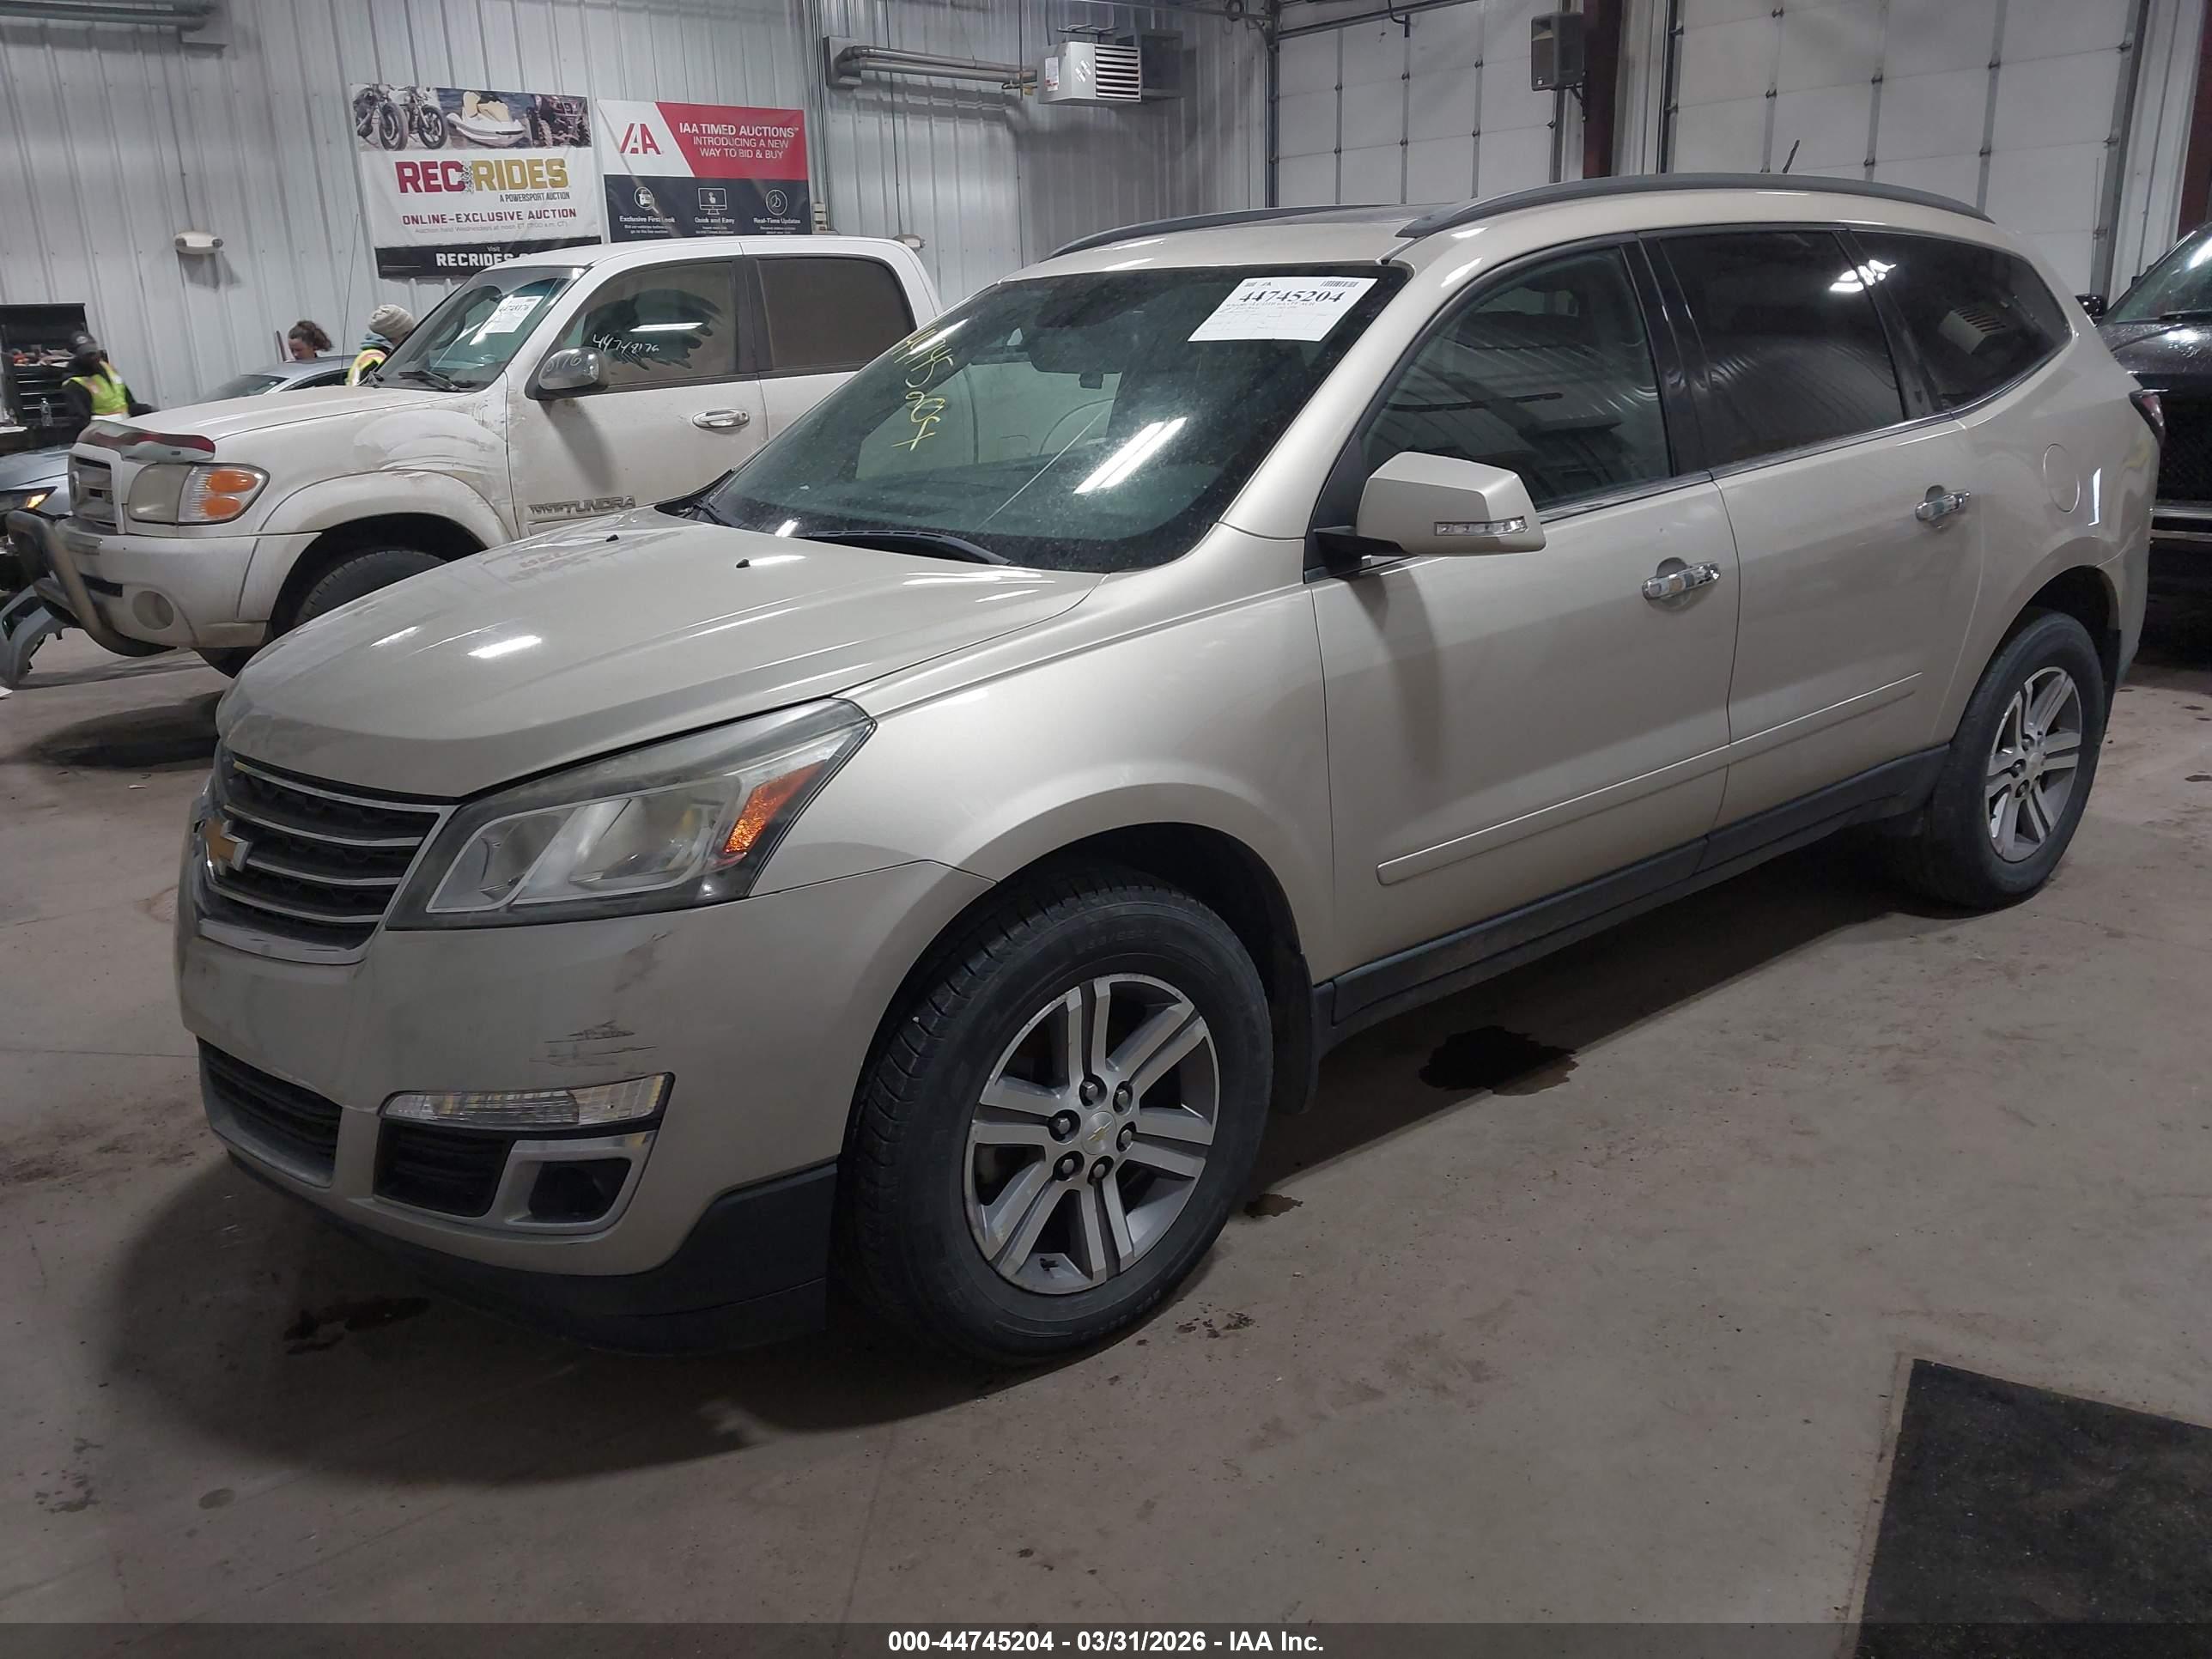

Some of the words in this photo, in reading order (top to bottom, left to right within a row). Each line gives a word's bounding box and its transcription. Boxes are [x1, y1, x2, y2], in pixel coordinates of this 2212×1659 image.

[679, 123, 699, 134] IAA
[700, 124, 736, 136] TIMED
[693, 137, 757, 147] INTRODUCING
[768, 140, 789, 149] NEW
[700, 148, 721, 157] WAY
[723, 149, 737, 157] TO
[738, 149, 753, 158] BID
[756, 150, 763, 159] &
[765, 150, 783, 159] BUY
[395, 161, 466, 193] REC
[472, 158, 569, 191] RIDES
[500, 194, 505, 203] A
[505, 192, 544, 203] POWERSPORT
[546, 191, 570, 200] AUCTION
[402, 210, 524, 225] ONLINE-EXCLUSIVE
[527, 208, 577, 220] AUCTION
[1239, 290, 1346, 302] 44745204
[565, 495, 636, 514] TUNDRA
